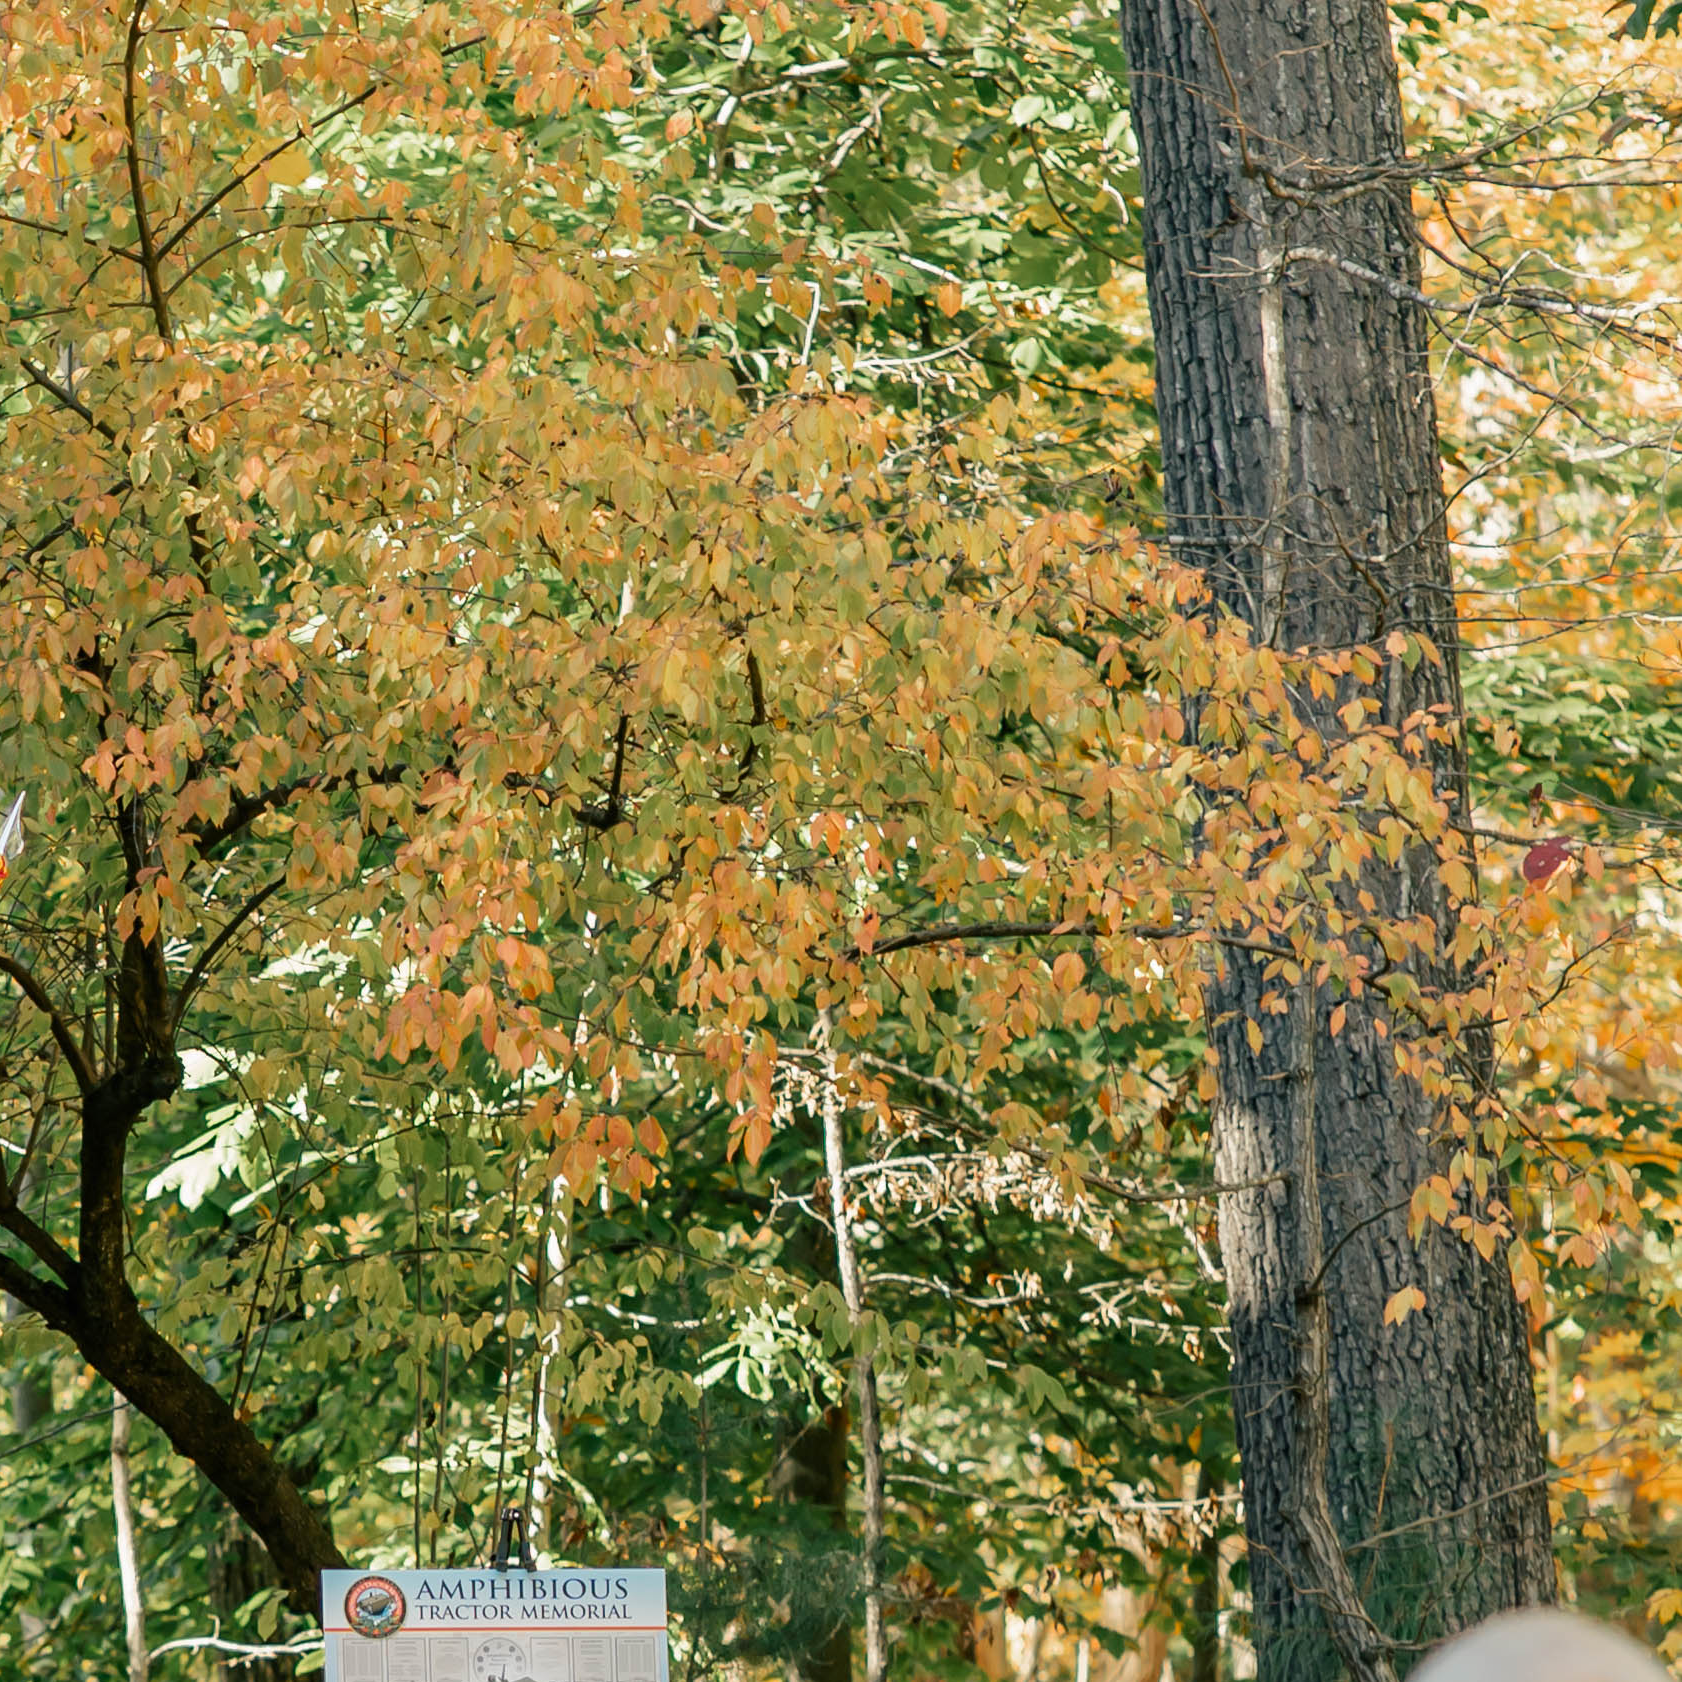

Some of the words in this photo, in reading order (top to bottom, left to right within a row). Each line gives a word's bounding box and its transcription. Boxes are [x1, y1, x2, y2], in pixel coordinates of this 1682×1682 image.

[415, 1577, 628, 1600] AMPHIBIOUS
[415, 1604, 512, 1620] TRACTOR
[520, 1604, 633, 1620] MEMORIAL
